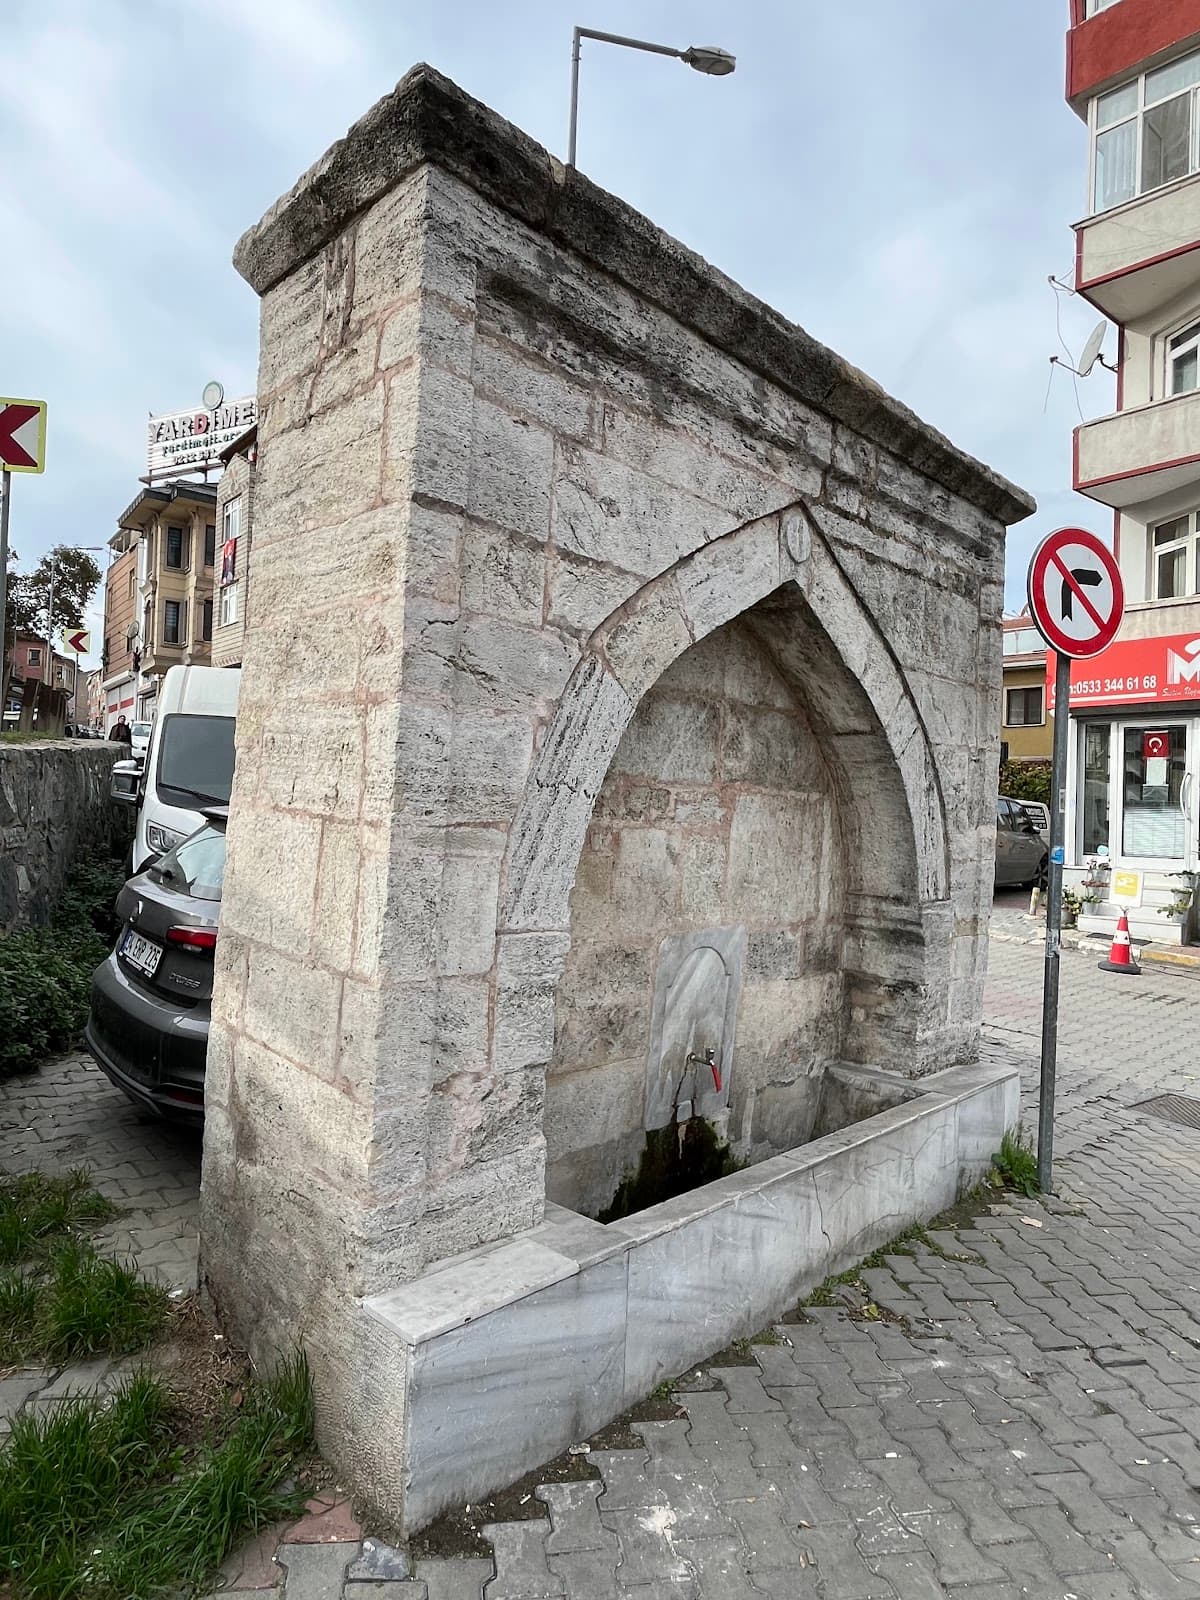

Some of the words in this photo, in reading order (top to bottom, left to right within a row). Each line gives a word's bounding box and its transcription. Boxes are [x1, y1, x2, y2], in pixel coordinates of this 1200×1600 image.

[1104, 677, 1123, 692] 344
[1126, 676, 1139, 690] 61
[1143, 675, 1157, 689] 68
